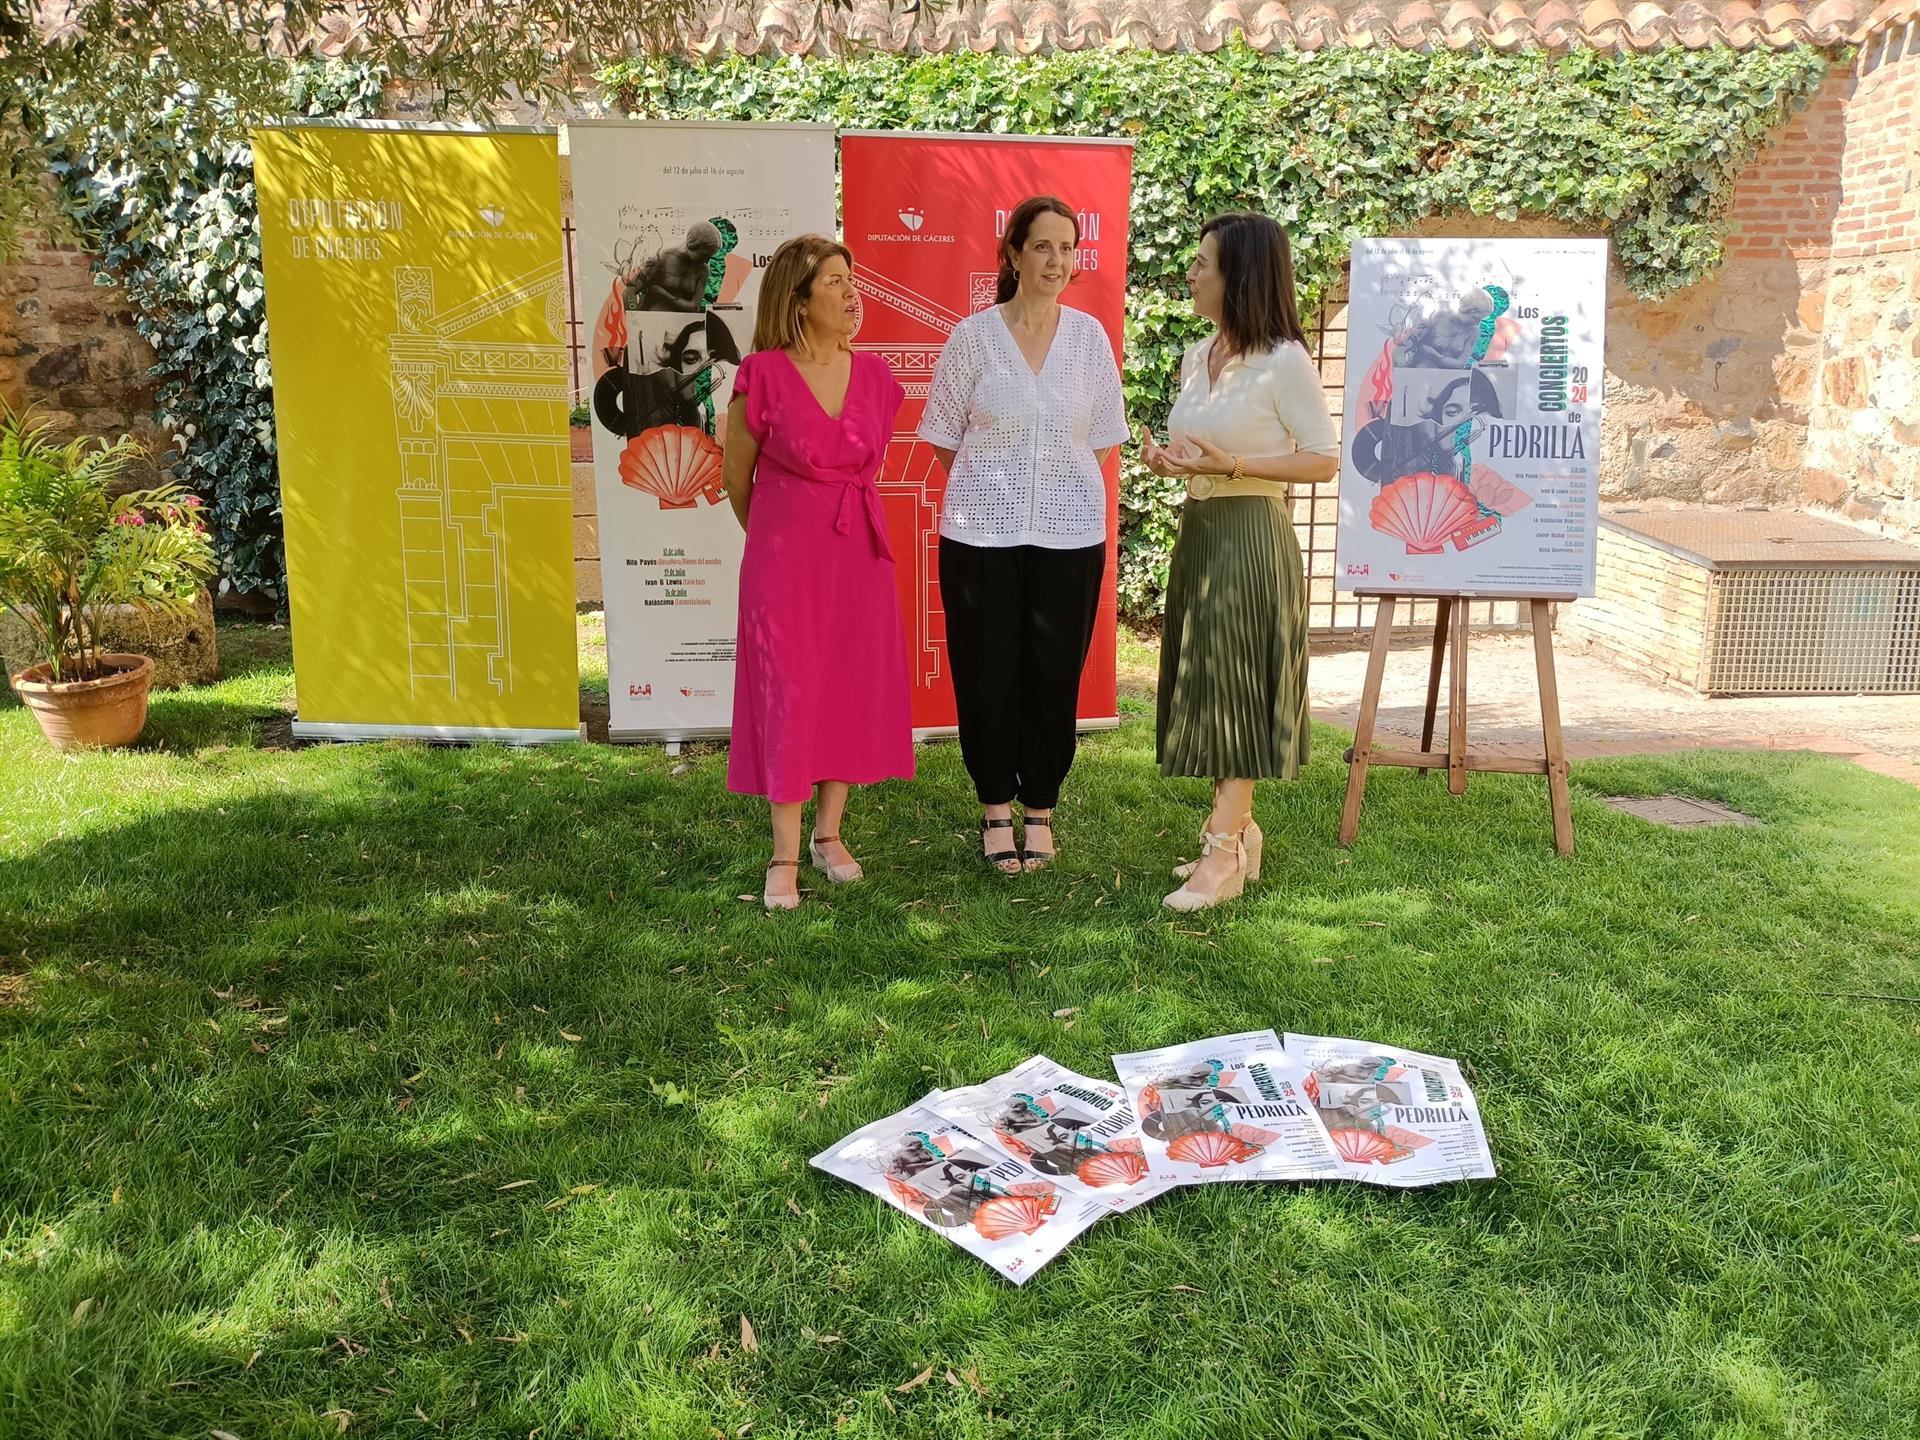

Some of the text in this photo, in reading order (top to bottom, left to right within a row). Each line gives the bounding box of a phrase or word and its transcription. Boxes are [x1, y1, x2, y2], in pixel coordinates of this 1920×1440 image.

[662, 166, 745, 176] del 12 de julio al 16 de agosto
[289, 198, 403, 230] DIPUTACIÓN
[867, 233, 955, 243] DIPUTACIÓN DE CÁCERES
[292, 234, 381, 260] DE CÁCERES
[1538, 315, 1569, 412] CONCIERTOS
[1572, 366, 1588, 383] 20
[1571, 385, 1588, 403] 24
[1568, 411, 1581, 423] de
[1489, 424, 1585, 460] PEDRILLA
[1105, 1089, 1119, 1098] 24
[1279, 1081, 1291, 1089] 20
[1283, 1088, 1296, 1097] 24
[1053, 1083, 1115, 1112] CONCIERTOS
[1236, 1103, 1308, 1120] PEDRILLA
[1394, 1107, 1469, 1124] PEDRILLA
